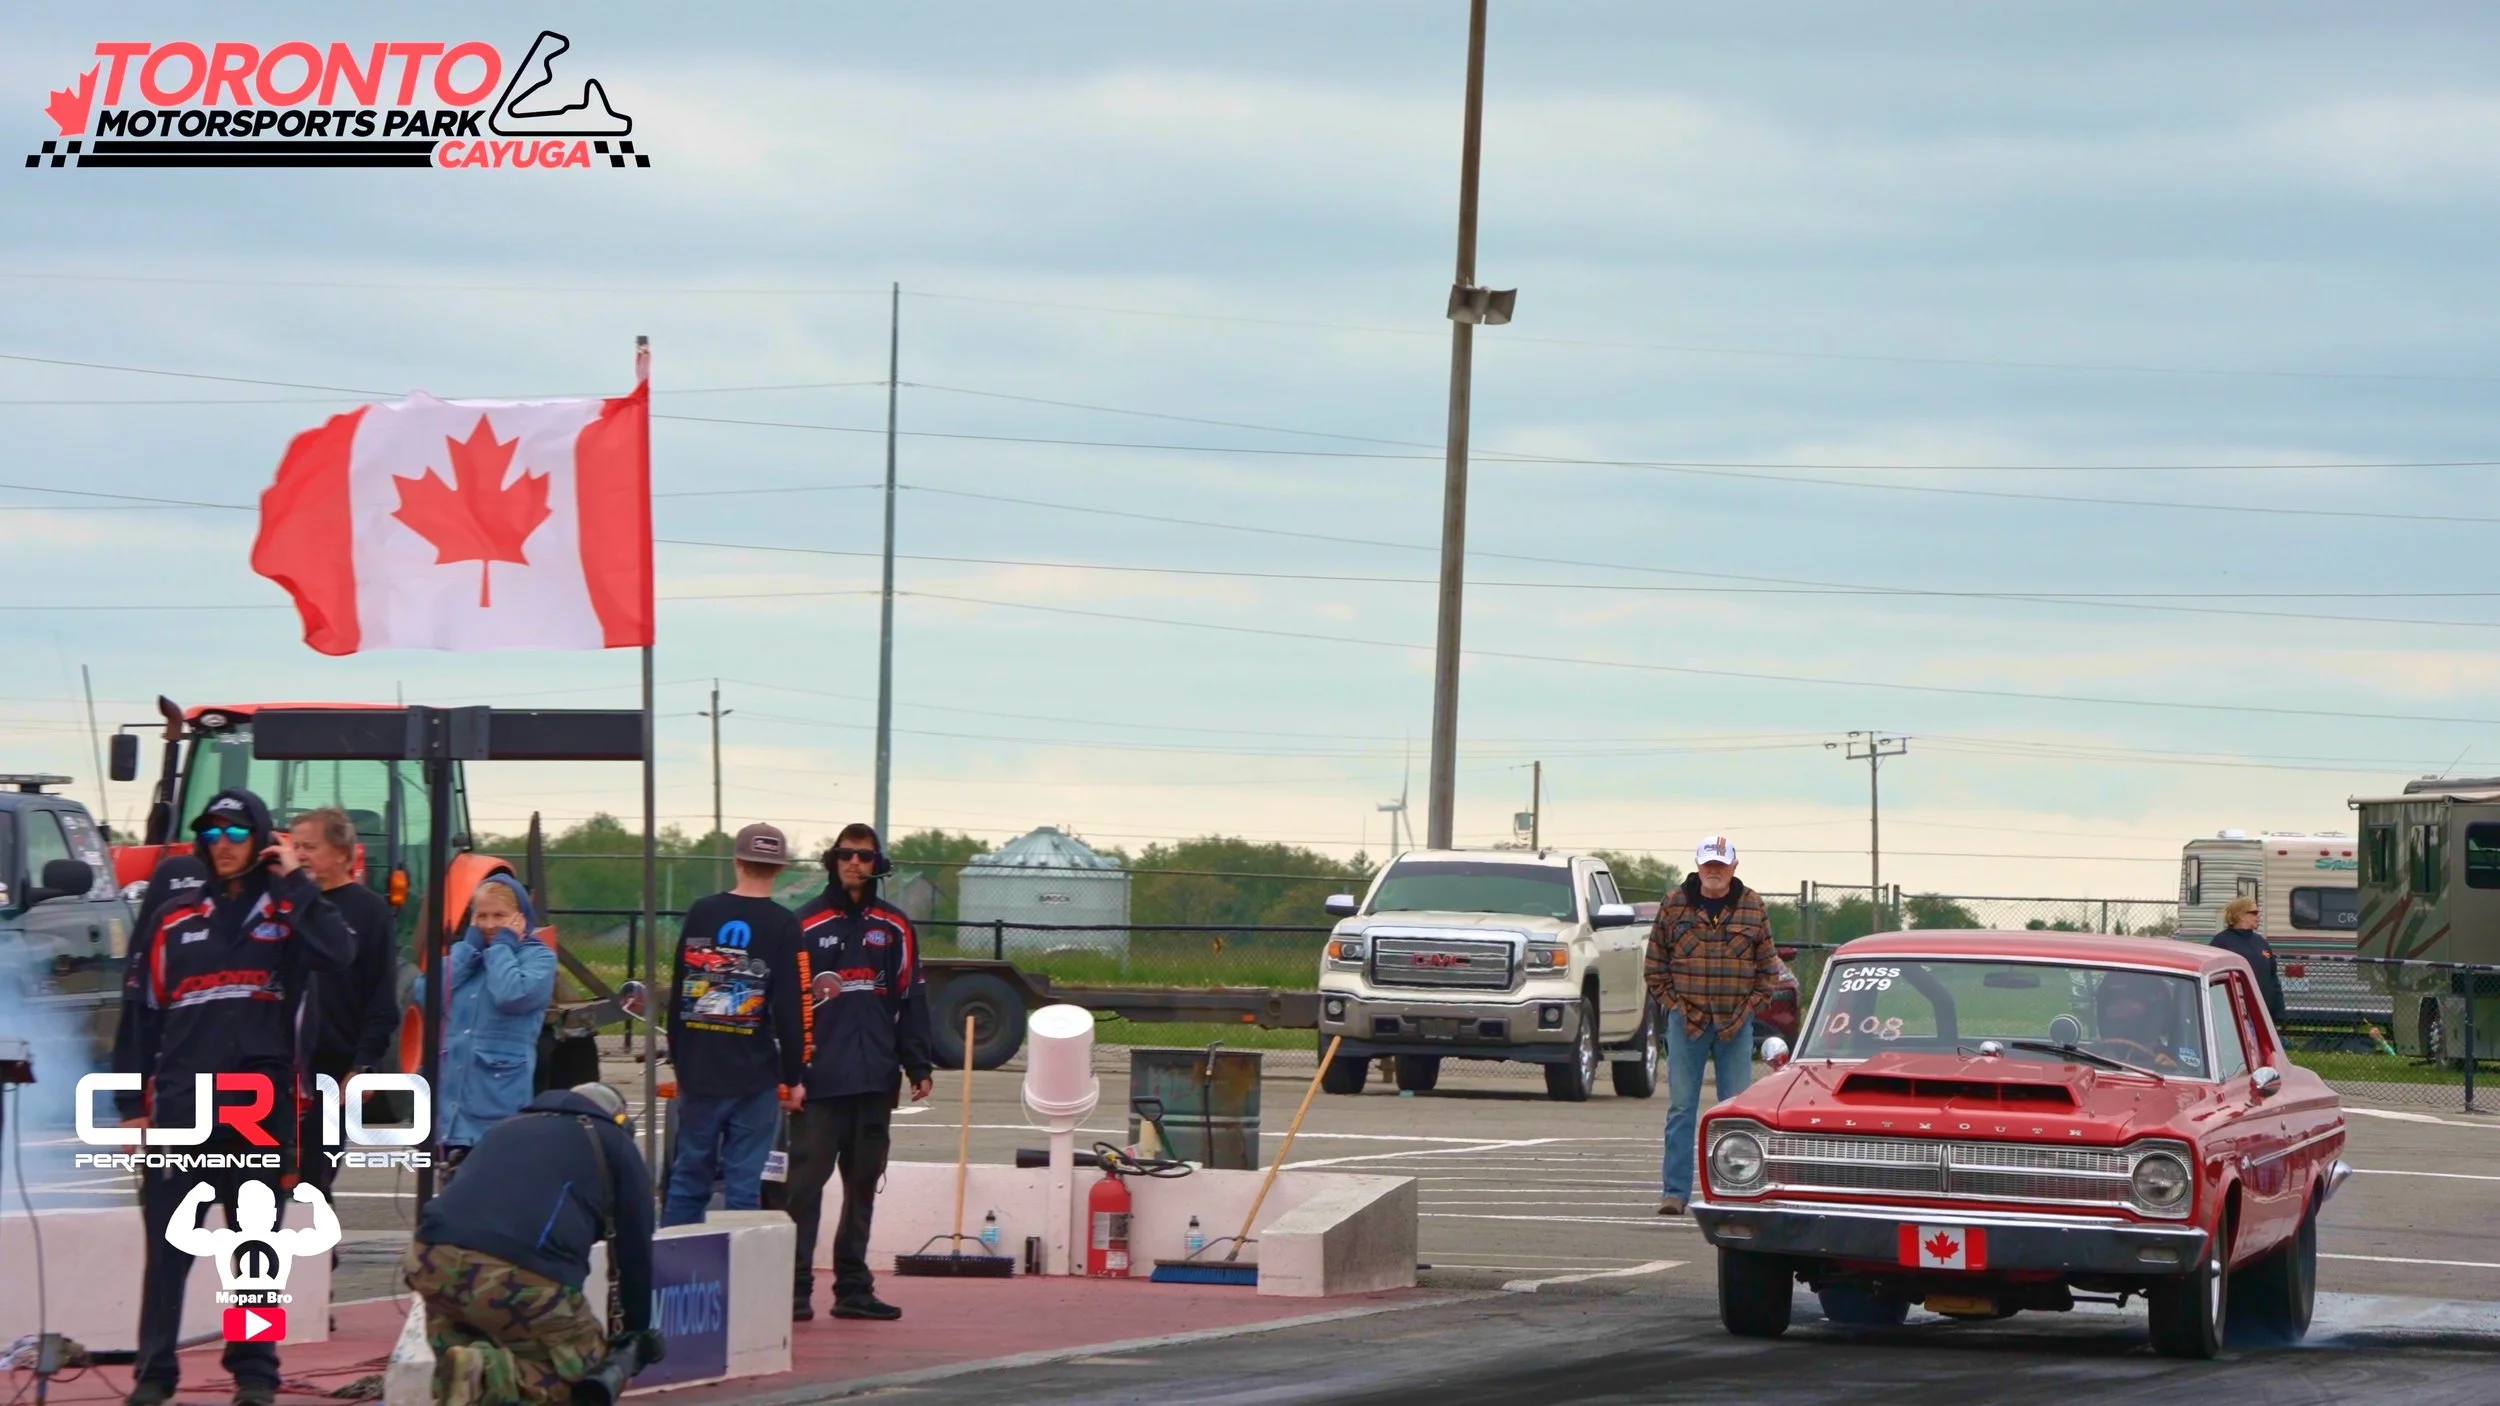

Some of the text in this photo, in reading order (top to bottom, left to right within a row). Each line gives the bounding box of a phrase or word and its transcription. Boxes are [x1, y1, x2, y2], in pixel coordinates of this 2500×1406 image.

[819, 935, 839, 949] Kyle
[1411, 951, 1471, 970] GMC
[1842, 967, 1901, 979] C-NSS
[179, 970, 269, 994] TORONTO
[1838, 978, 1892, 993] 3079
[1810, 1117, 2083, 1137] PLYMOUTH
